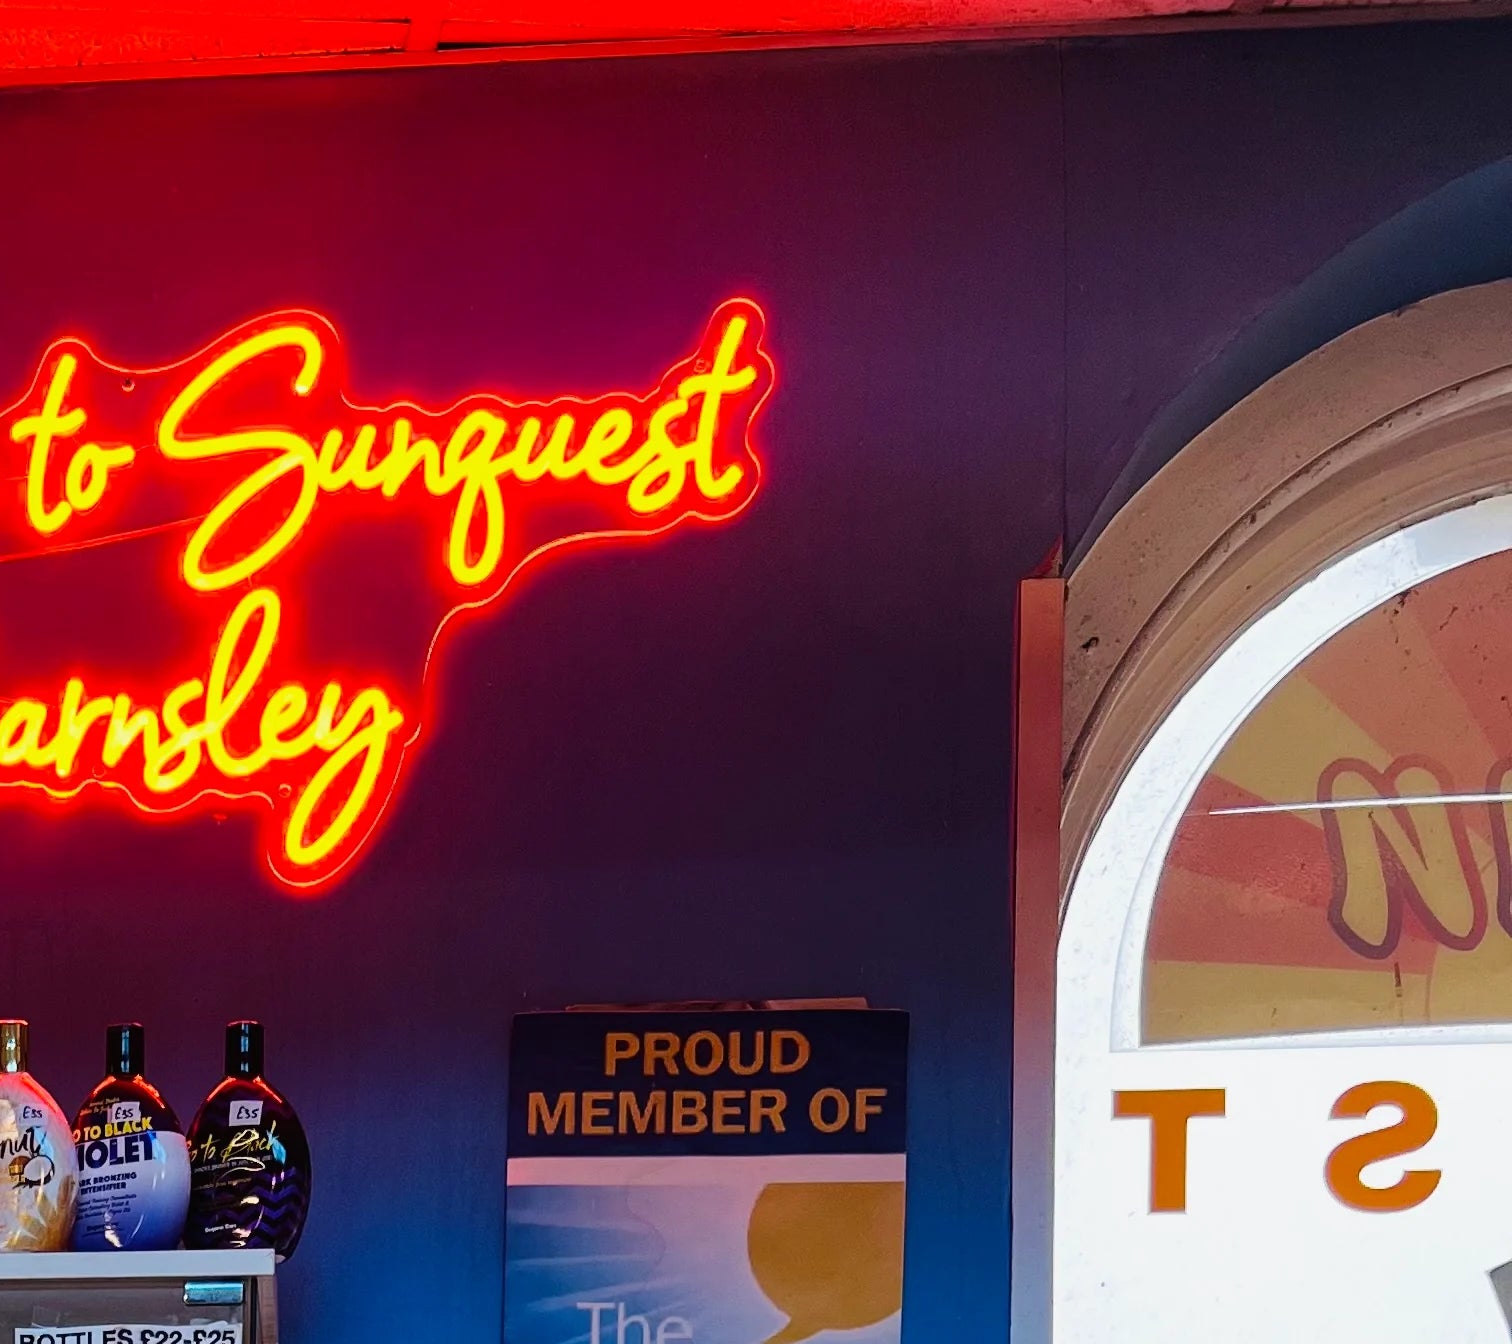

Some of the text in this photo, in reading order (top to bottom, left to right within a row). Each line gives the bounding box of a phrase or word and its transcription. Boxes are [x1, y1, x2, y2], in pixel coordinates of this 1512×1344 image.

[11, 351, 137, 535] to
[158, 313, 760, 596] Sunquest
[604, 1029, 811, 1076] PROUD
[84, 1117, 152, 1138] TO BLACK
[236, 1106, 260, 1119] £35
[527, 1087, 887, 1136] MEMBER OF
